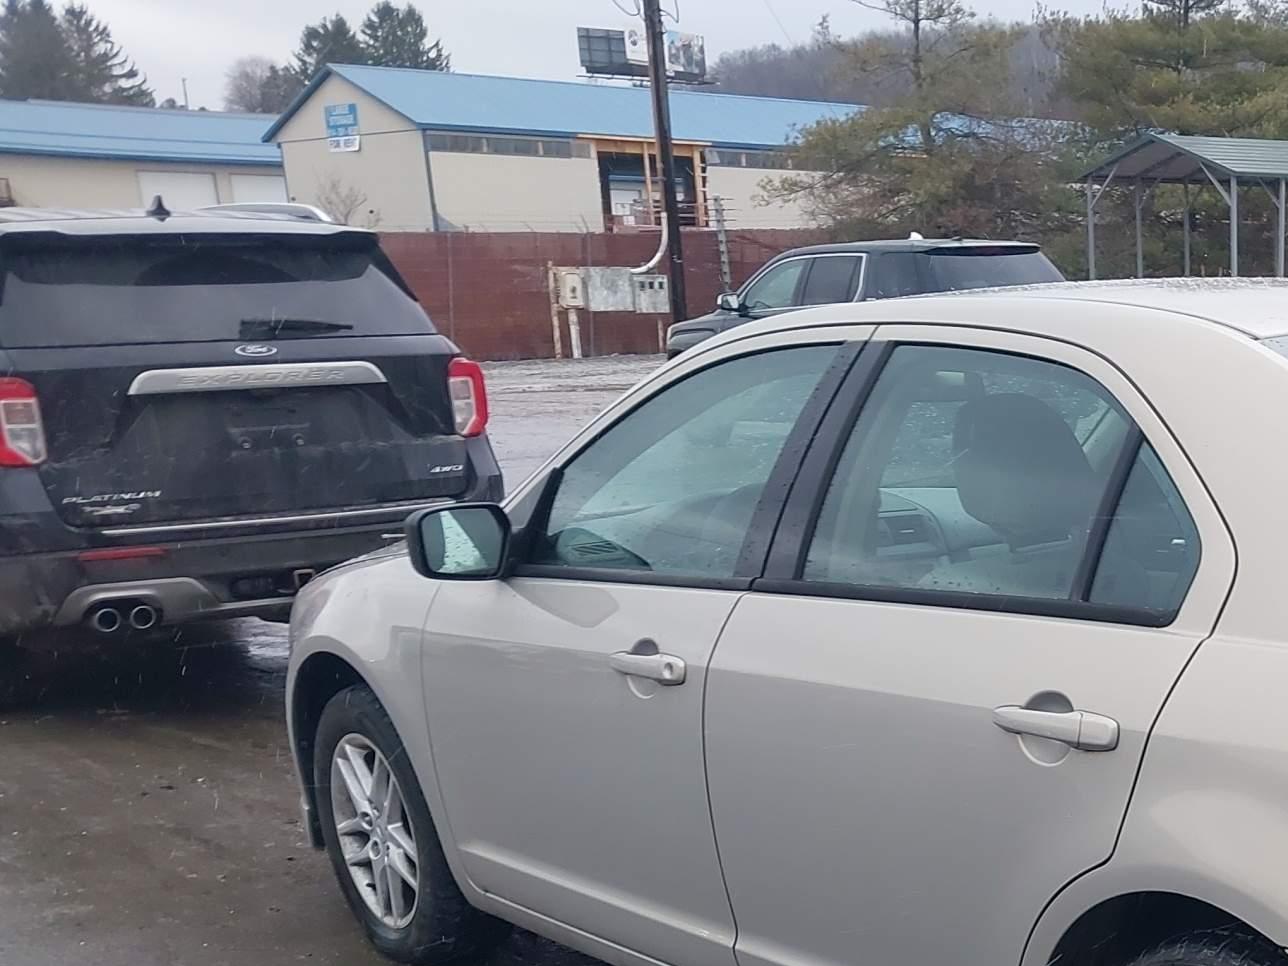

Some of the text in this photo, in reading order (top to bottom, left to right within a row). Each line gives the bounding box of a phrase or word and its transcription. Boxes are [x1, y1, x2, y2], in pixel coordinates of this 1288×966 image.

[180, 369, 346, 387] EXPLORER
[430, 464, 464, 473] 4WD
[62, 490, 161, 504] PLATINUM
